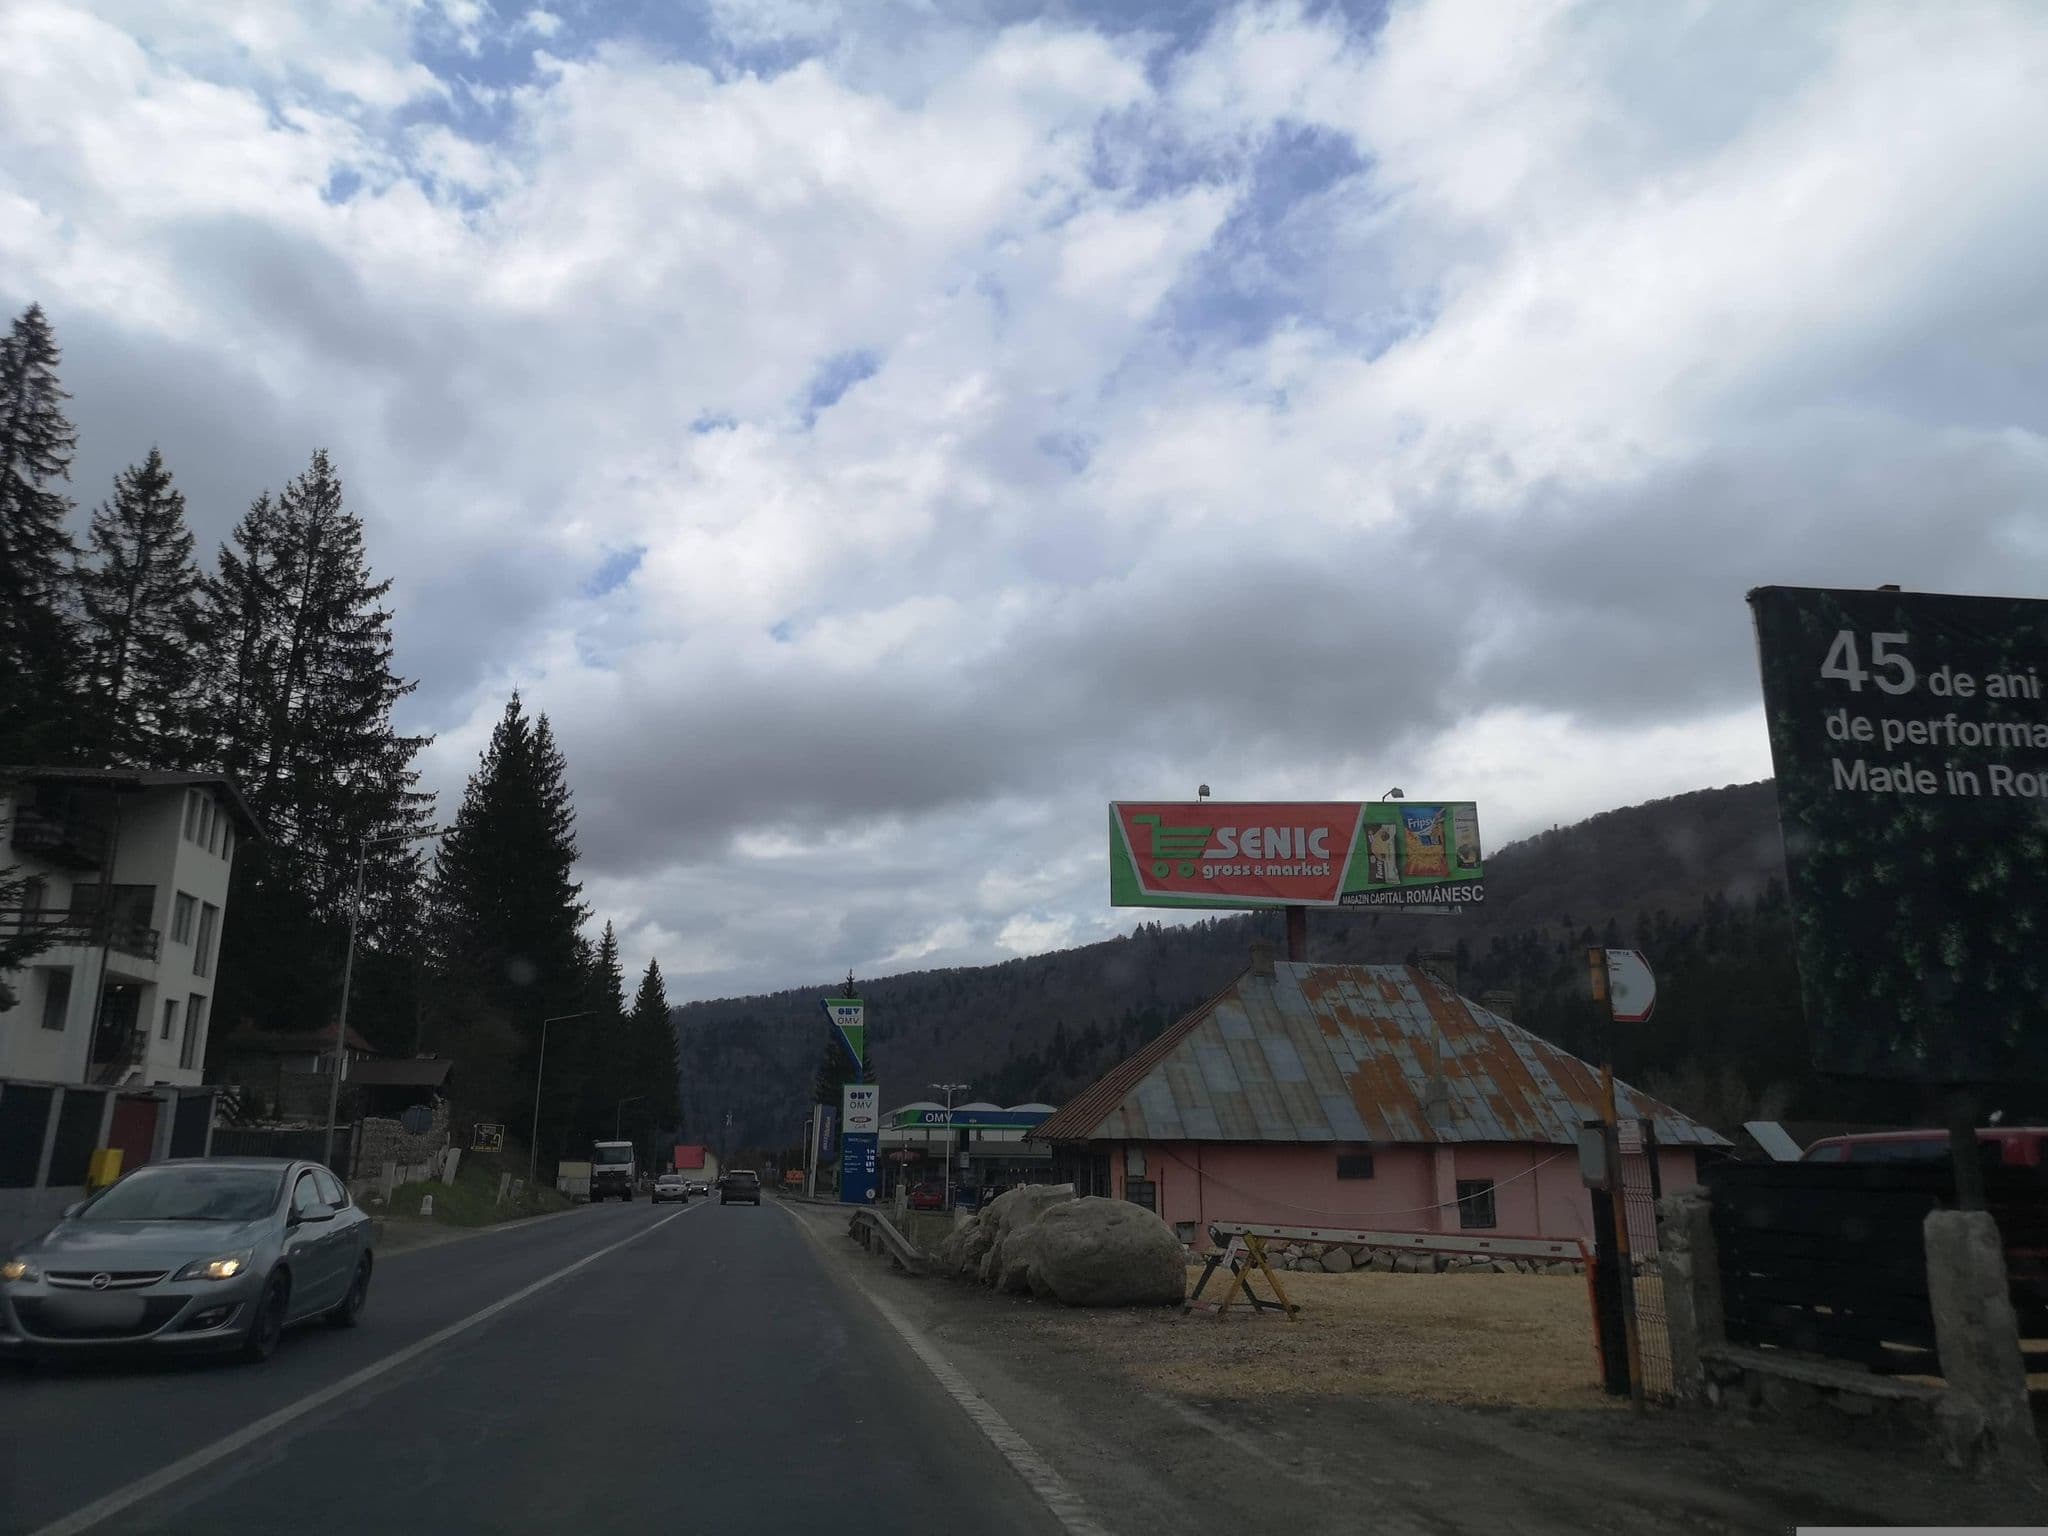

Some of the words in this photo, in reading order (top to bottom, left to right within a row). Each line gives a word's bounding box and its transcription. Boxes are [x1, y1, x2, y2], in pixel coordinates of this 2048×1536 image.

[1820, 630, 1917, 696] 45
[1928, 665, 1976, 698] de
[1985, 667, 2040, 699] ani
[1826, 708, 1874, 742] de
[1880, 713, 2048, 751] performa
[1832, 758, 1938, 794] Made
[1945, 763, 1981, 796] in
[1407, 817, 1436, 832] Fripsy
[1203, 827, 1330, 860] SENIC
[1202, 863, 1251, 879] gross
[1254, 866, 1264, 876] &
[1266, 862, 1331, 877] market
[1342, 893, 1369, 905] MAGAZIN
[1370, 891, 1405, 905] CAPITAL
[1406, 885, 1485, 905] ROMÂNESC
[837, 1016, 859, 1025] OMV
[849, 1101, 872, 1110] OMV
[925, 1112, 953, 1123] OMV
